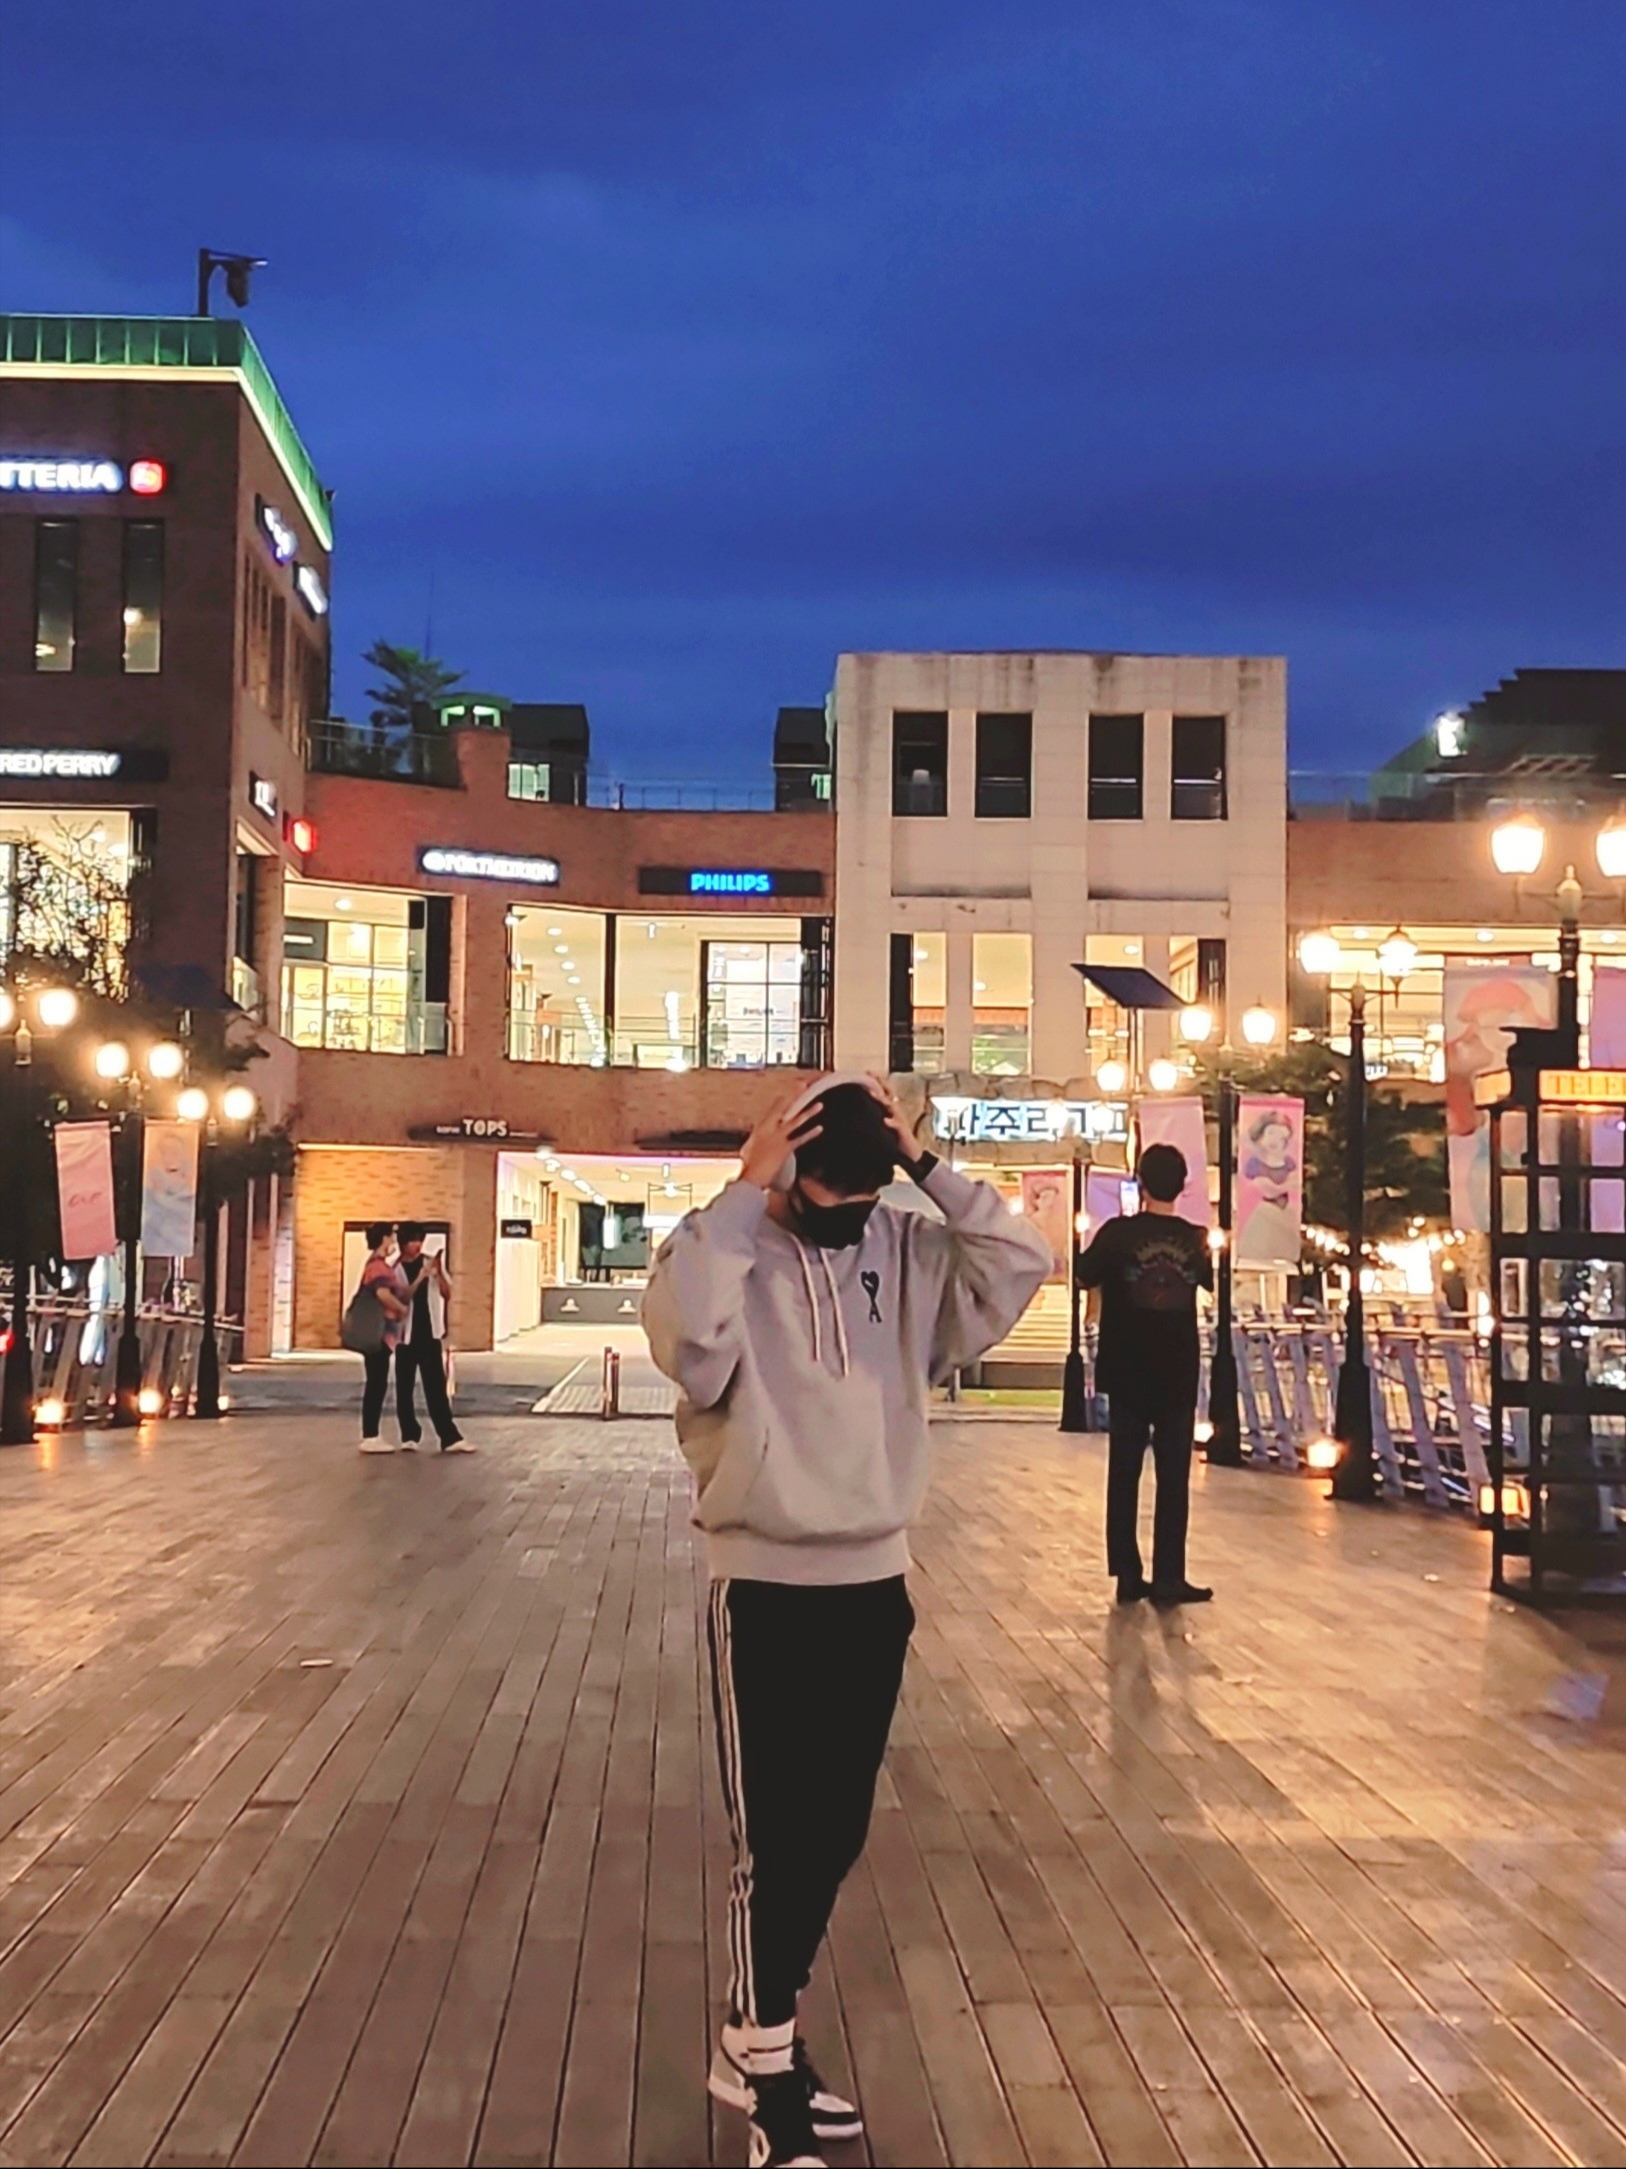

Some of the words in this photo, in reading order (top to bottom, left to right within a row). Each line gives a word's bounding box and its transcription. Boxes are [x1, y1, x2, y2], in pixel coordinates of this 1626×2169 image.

[42, 754, 119, 776] PERRY
[691, 873, 769, 891] PHILIPS
[463, 1118, 508, 1137] TOPS
